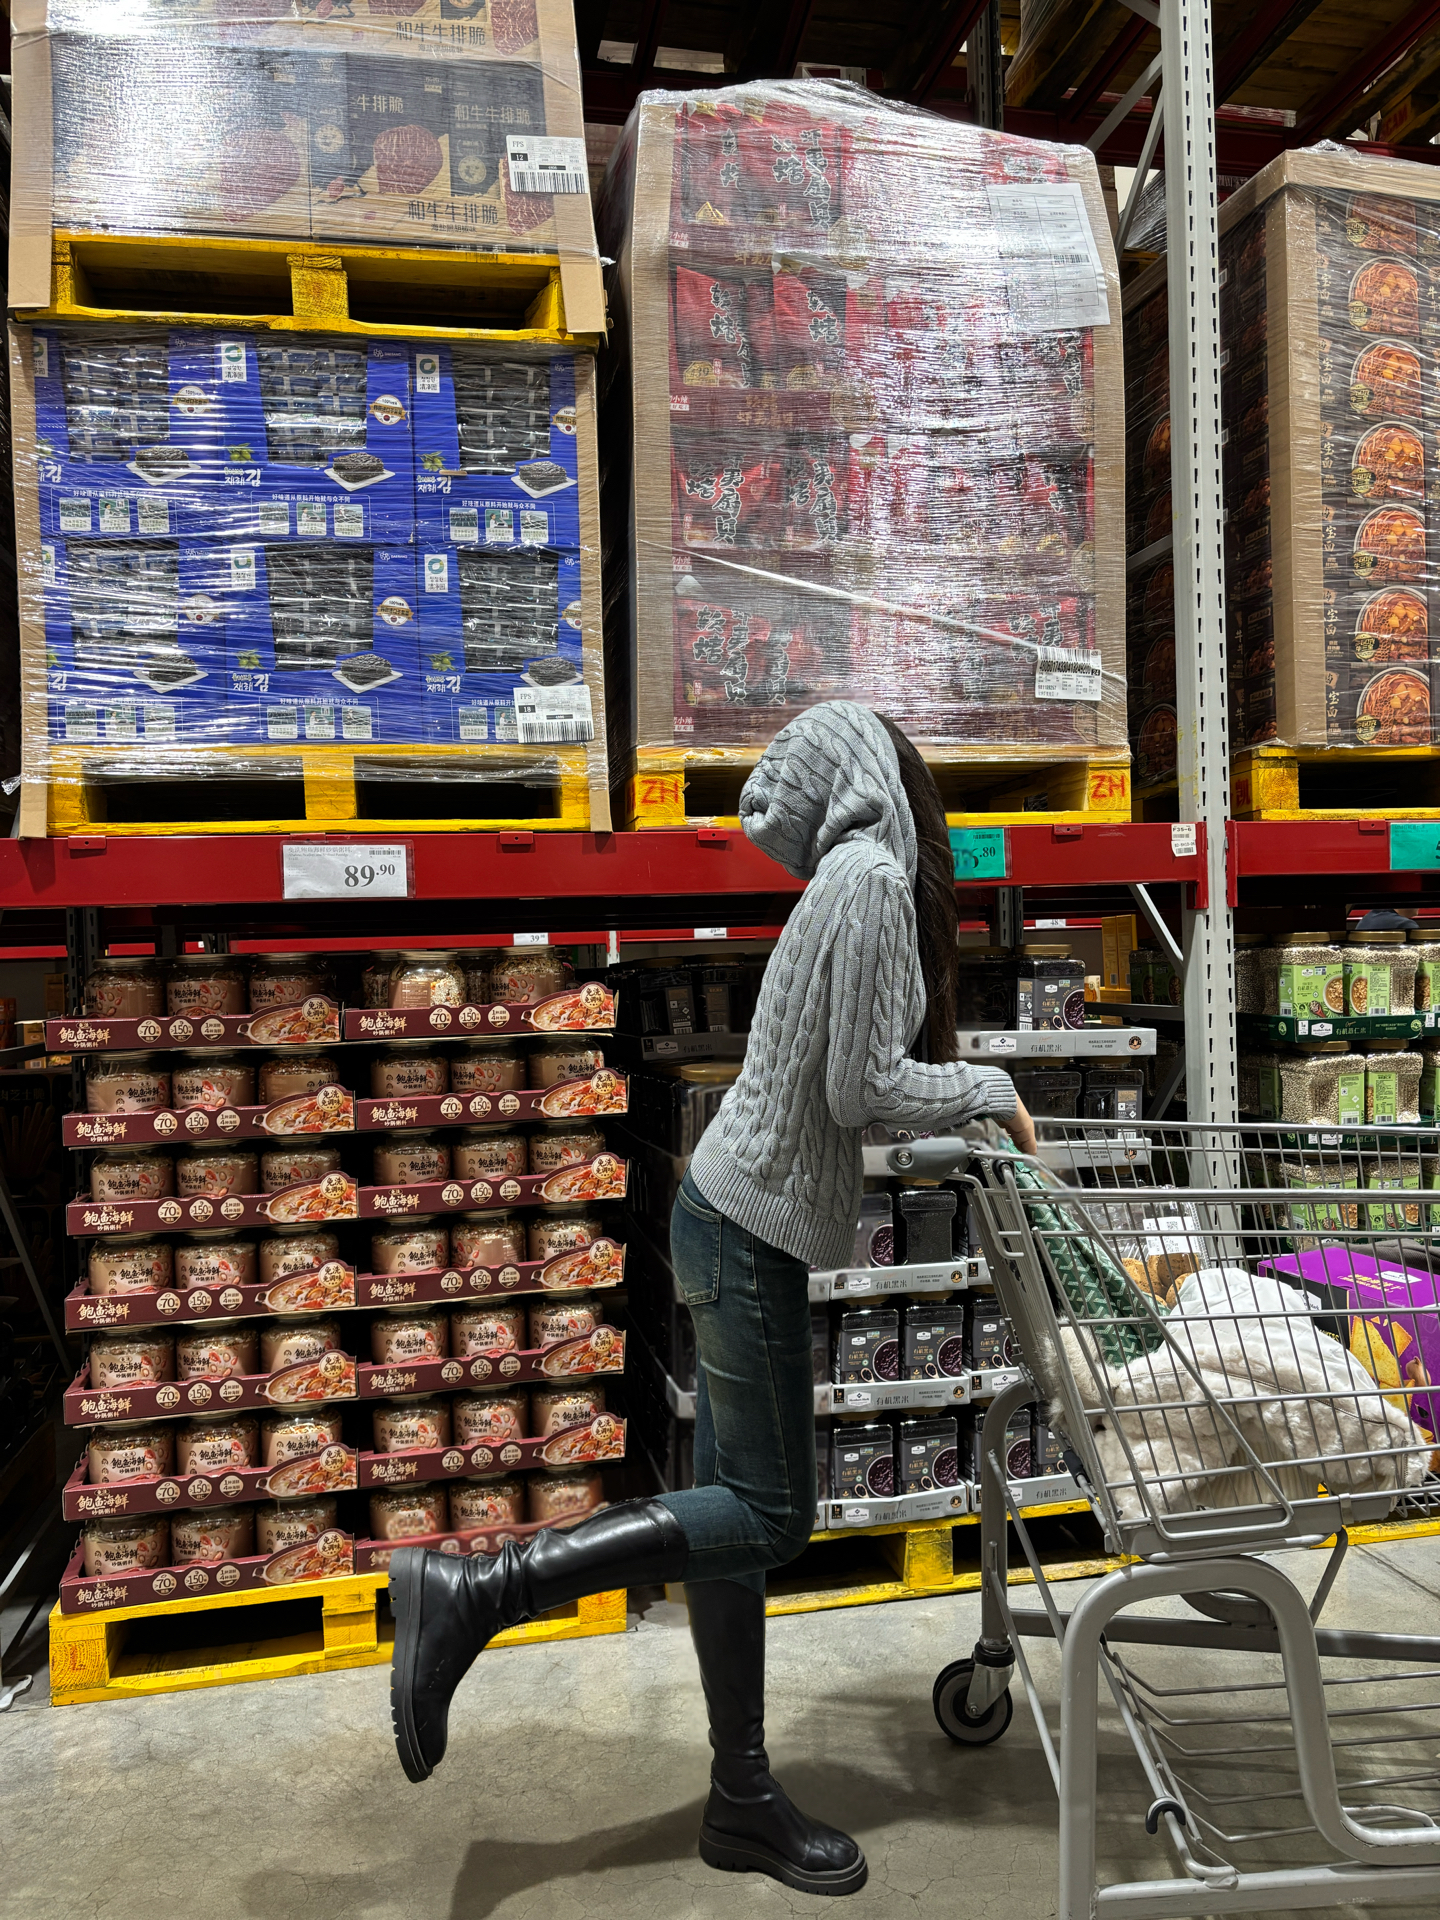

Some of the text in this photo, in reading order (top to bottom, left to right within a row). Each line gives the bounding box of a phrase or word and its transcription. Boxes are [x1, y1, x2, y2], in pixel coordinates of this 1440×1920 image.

[408, 200, 499, 225] 和牛牛排脆
[245, 468, 261, 487] 김
[437, 476, 452, 494] 김
[254, 673, 270, 692] 김
[446, 675, 461, 694] 김
[1091, 774, 1126, 800] ZH
[344, 864, 396, 888] 89.90
[358, 1016, 408, 1032] 鲍鱼海鲜
[58, 1026, 112, 1044] 鲍鱼海鲜
[1030, 1044, 1062, 1053] 有机黑米
[370, 1106, 419, 1122] 鲍鱼海鲜
[74, 1122, 128, 1140] 鲍鱼海鲜
[372, 1193, 420, 1210] 鲍鱼海鲜
[81, 1210, 135, 1228] 鲍鱼海鲜
[368, 1282, 417, 1298] 鲍鱼海鲜
[876, 1280, 908, 1290] 有机黑米
[77, 1302, 130, 1321] 鲍鱼海鲜
[370, 1373, 418, 1390] 鲍鱼海鲜
[78, 1397, 132, 1416] 鲍鱼海鲜
[876, 1395, 910, 1406] 有机黑米
[370, 1462, 419, 1478] 鲍鱼海鲜
[75, 1493, 130, 1512] 鲍鱼海鲜
[76, 1586, 130, 1604] 鲍鱼海鲜
